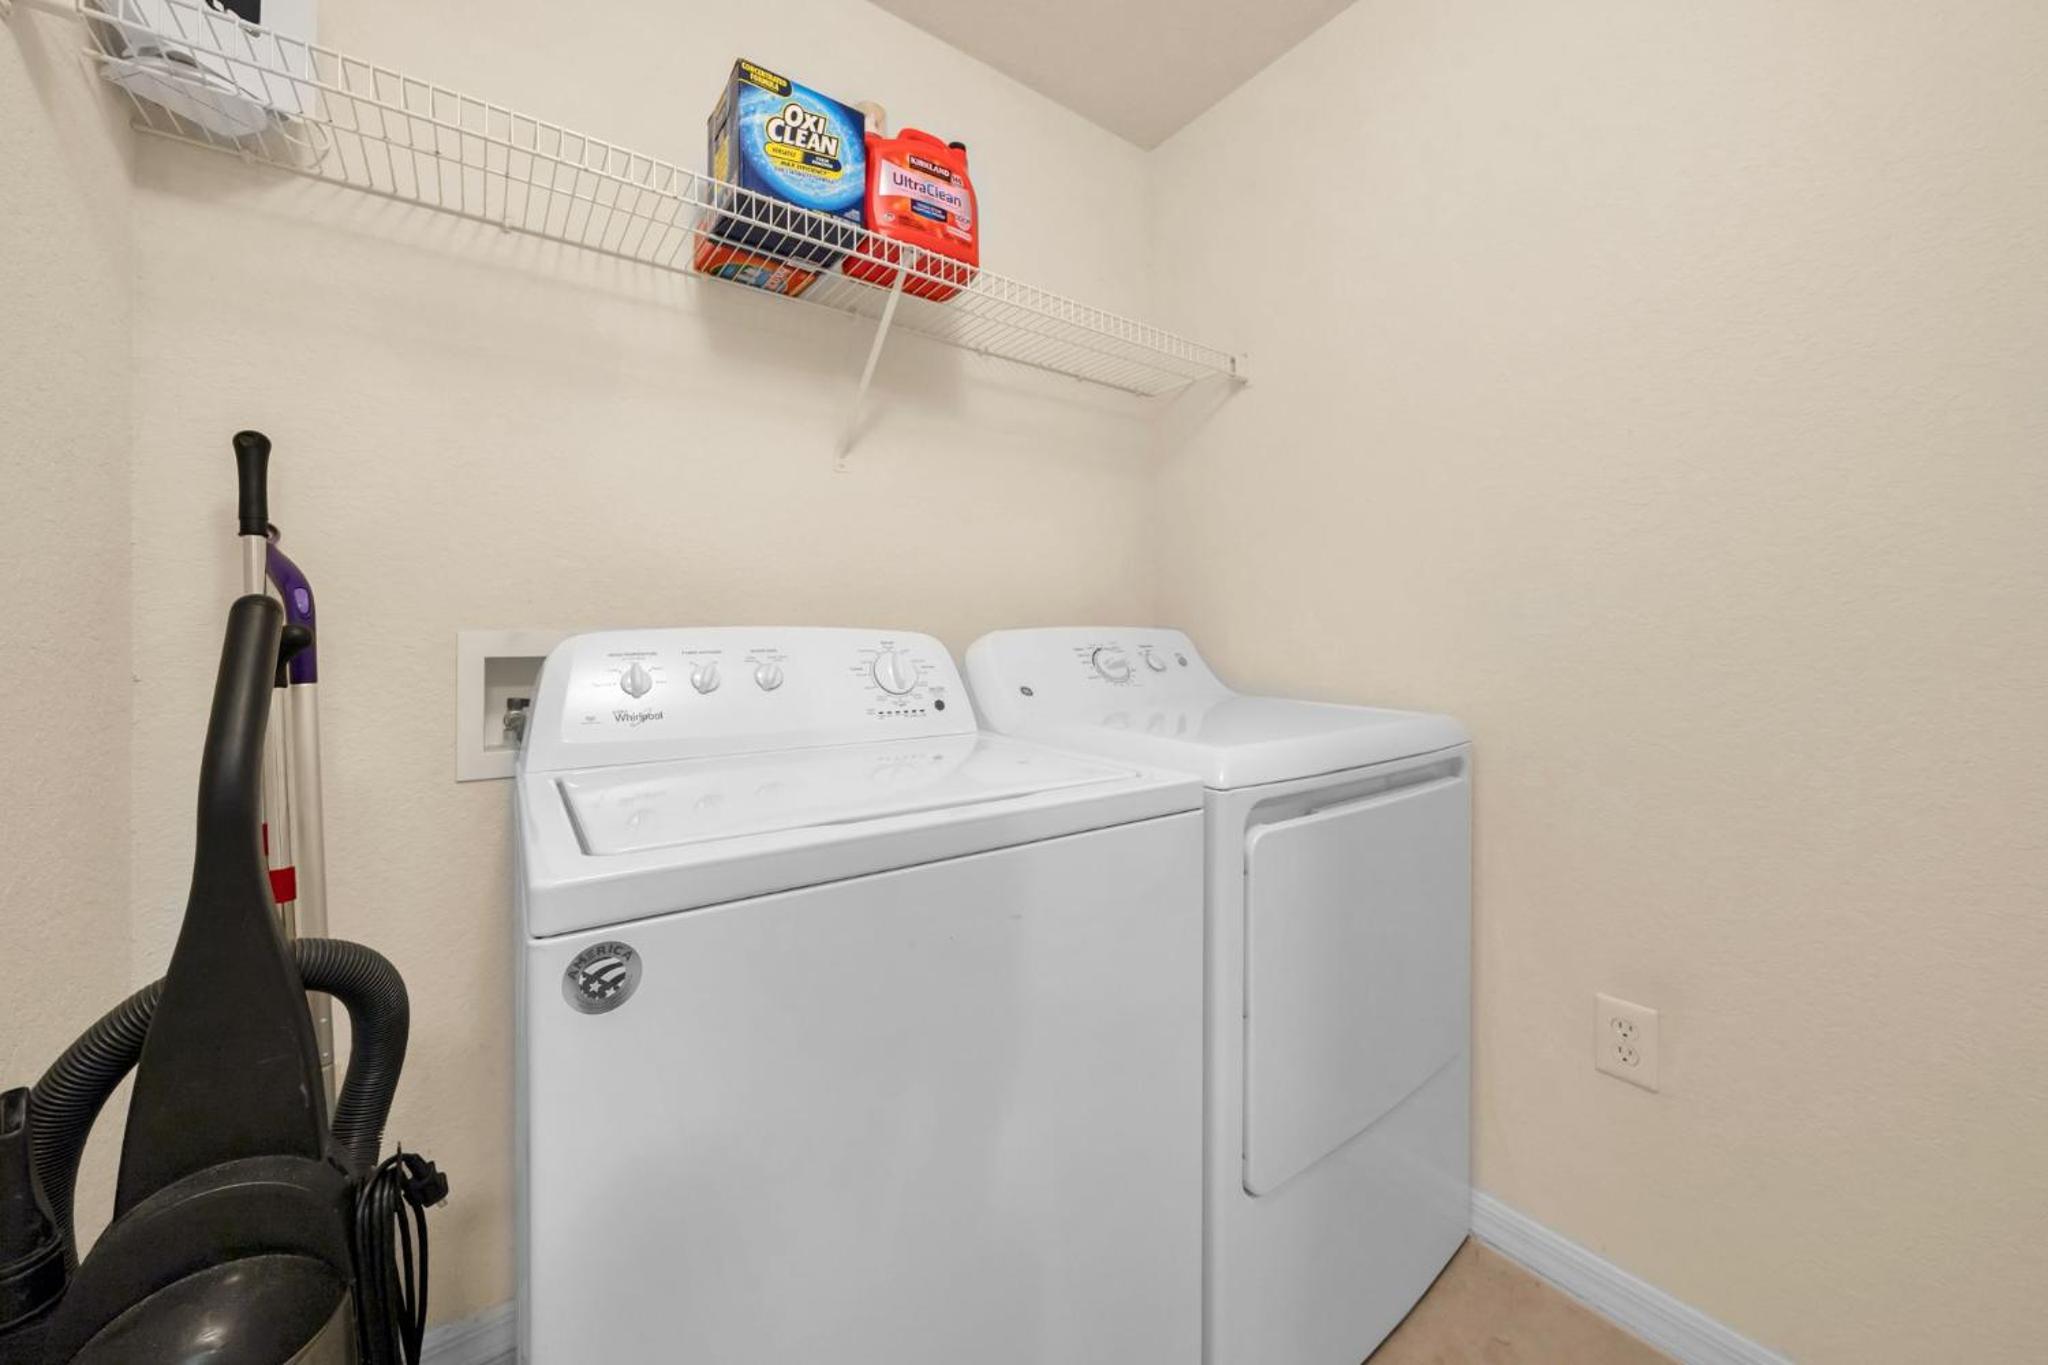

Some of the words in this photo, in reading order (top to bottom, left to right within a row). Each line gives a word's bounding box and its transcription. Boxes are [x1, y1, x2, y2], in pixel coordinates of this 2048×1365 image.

[784, 103, 826, 135] OXI
[766, 117, 838, 156] CLEAN
[910, 156, 950, 178] KIRKLAND
[892, 172, 962, 207] UltraClean
[613, 709, 663, 724] Whirlpool
[567, 944, 633, 981] AMERICA
